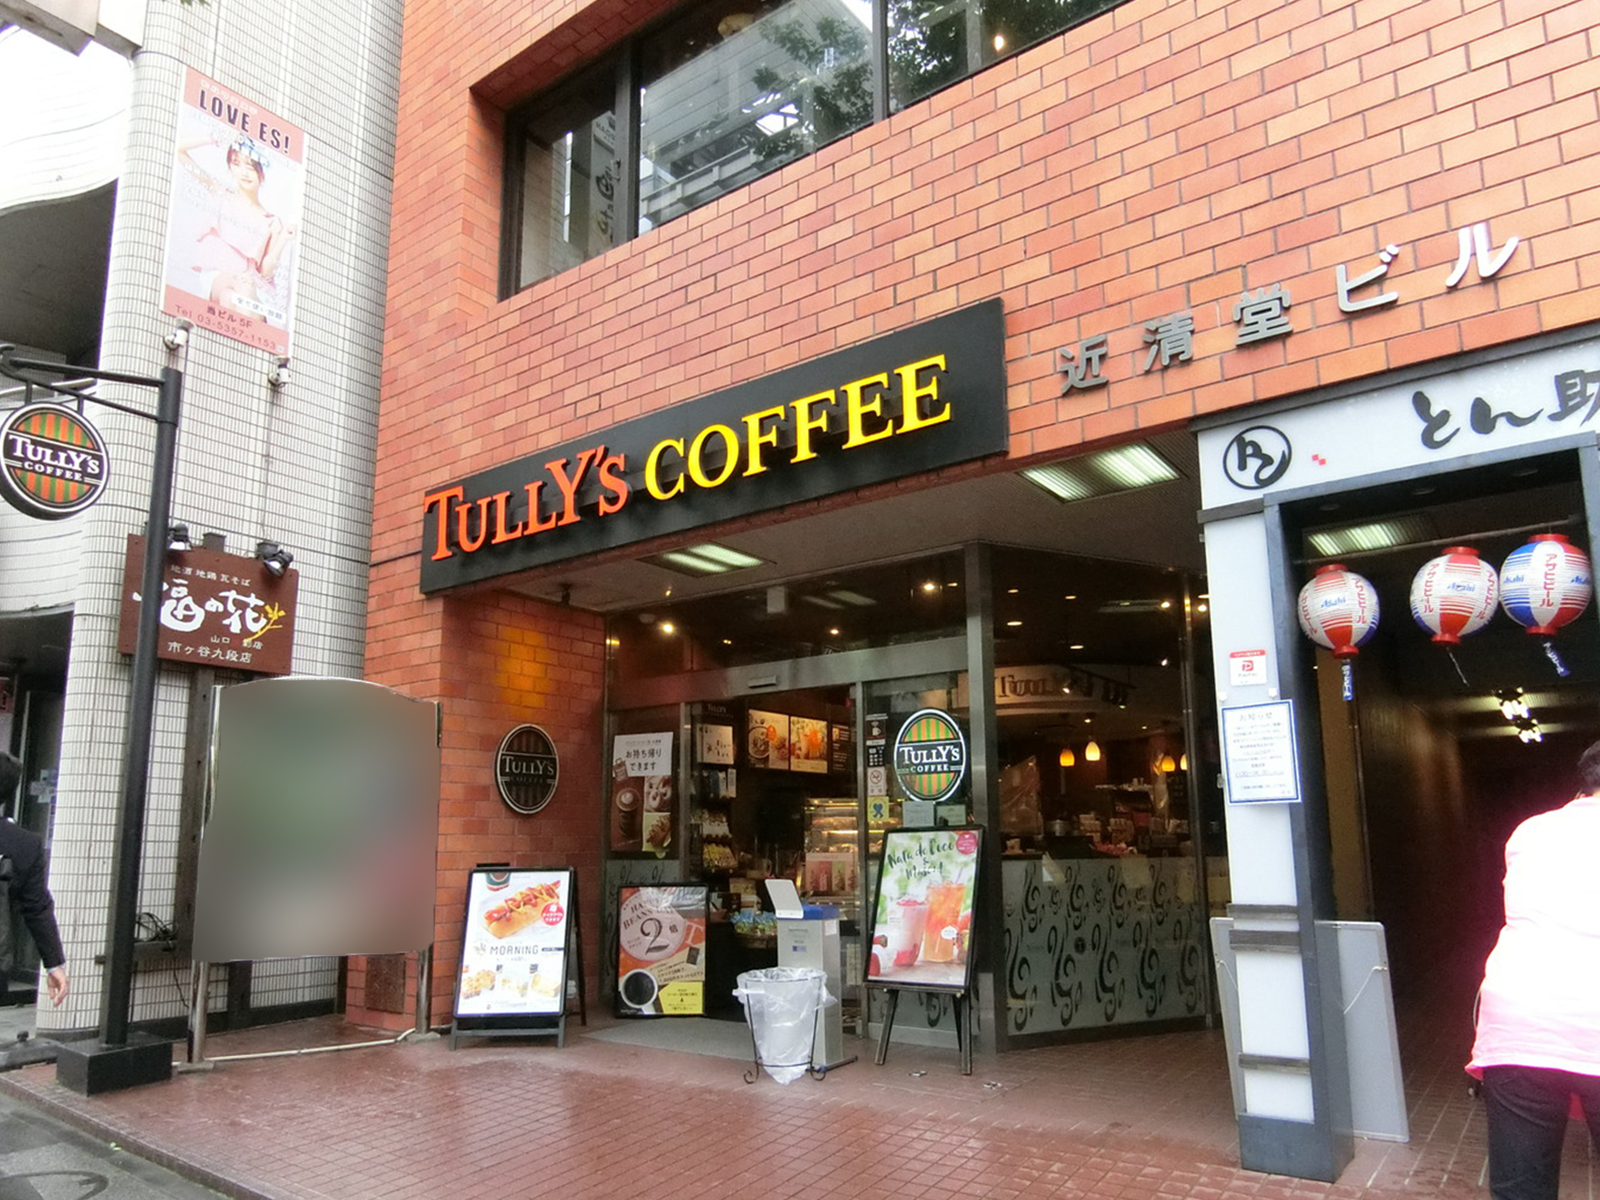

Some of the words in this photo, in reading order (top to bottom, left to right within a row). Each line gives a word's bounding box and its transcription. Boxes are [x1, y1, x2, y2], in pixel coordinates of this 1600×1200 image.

[199, 88, 250, 133] LOVE
[258, 121, 290, 155] ES!
[206, 304, 237, 323] 当ビル
[239, 317, 254, 329] 5F
[1058, 221, 1521, 394] 近清堂ビル
[174, 303, 193, 320] Tel
[197, 313, 277, 351] 03-5357-1153
[8, 434, 101, 475] TULLY'S
[423, 444, 629, 561] TULLY'S
[643, 352, 953, 501] COFFEE
[24, 461, 83, 482] COFFEE
[1423, 563, 1441, 614] アサヒビール
[1539, 553, 1558, 608] アサヒビール
[210, 635, 231, 644] 山口
[626, 748, 662, 759] お持ち帰り
[630, 761, 656, 771] できます
[899, 744, 961, 765] TULLY'S
[910, 763, 950, 773] COFFEE
[489, 945, 539, 955] MORNING
